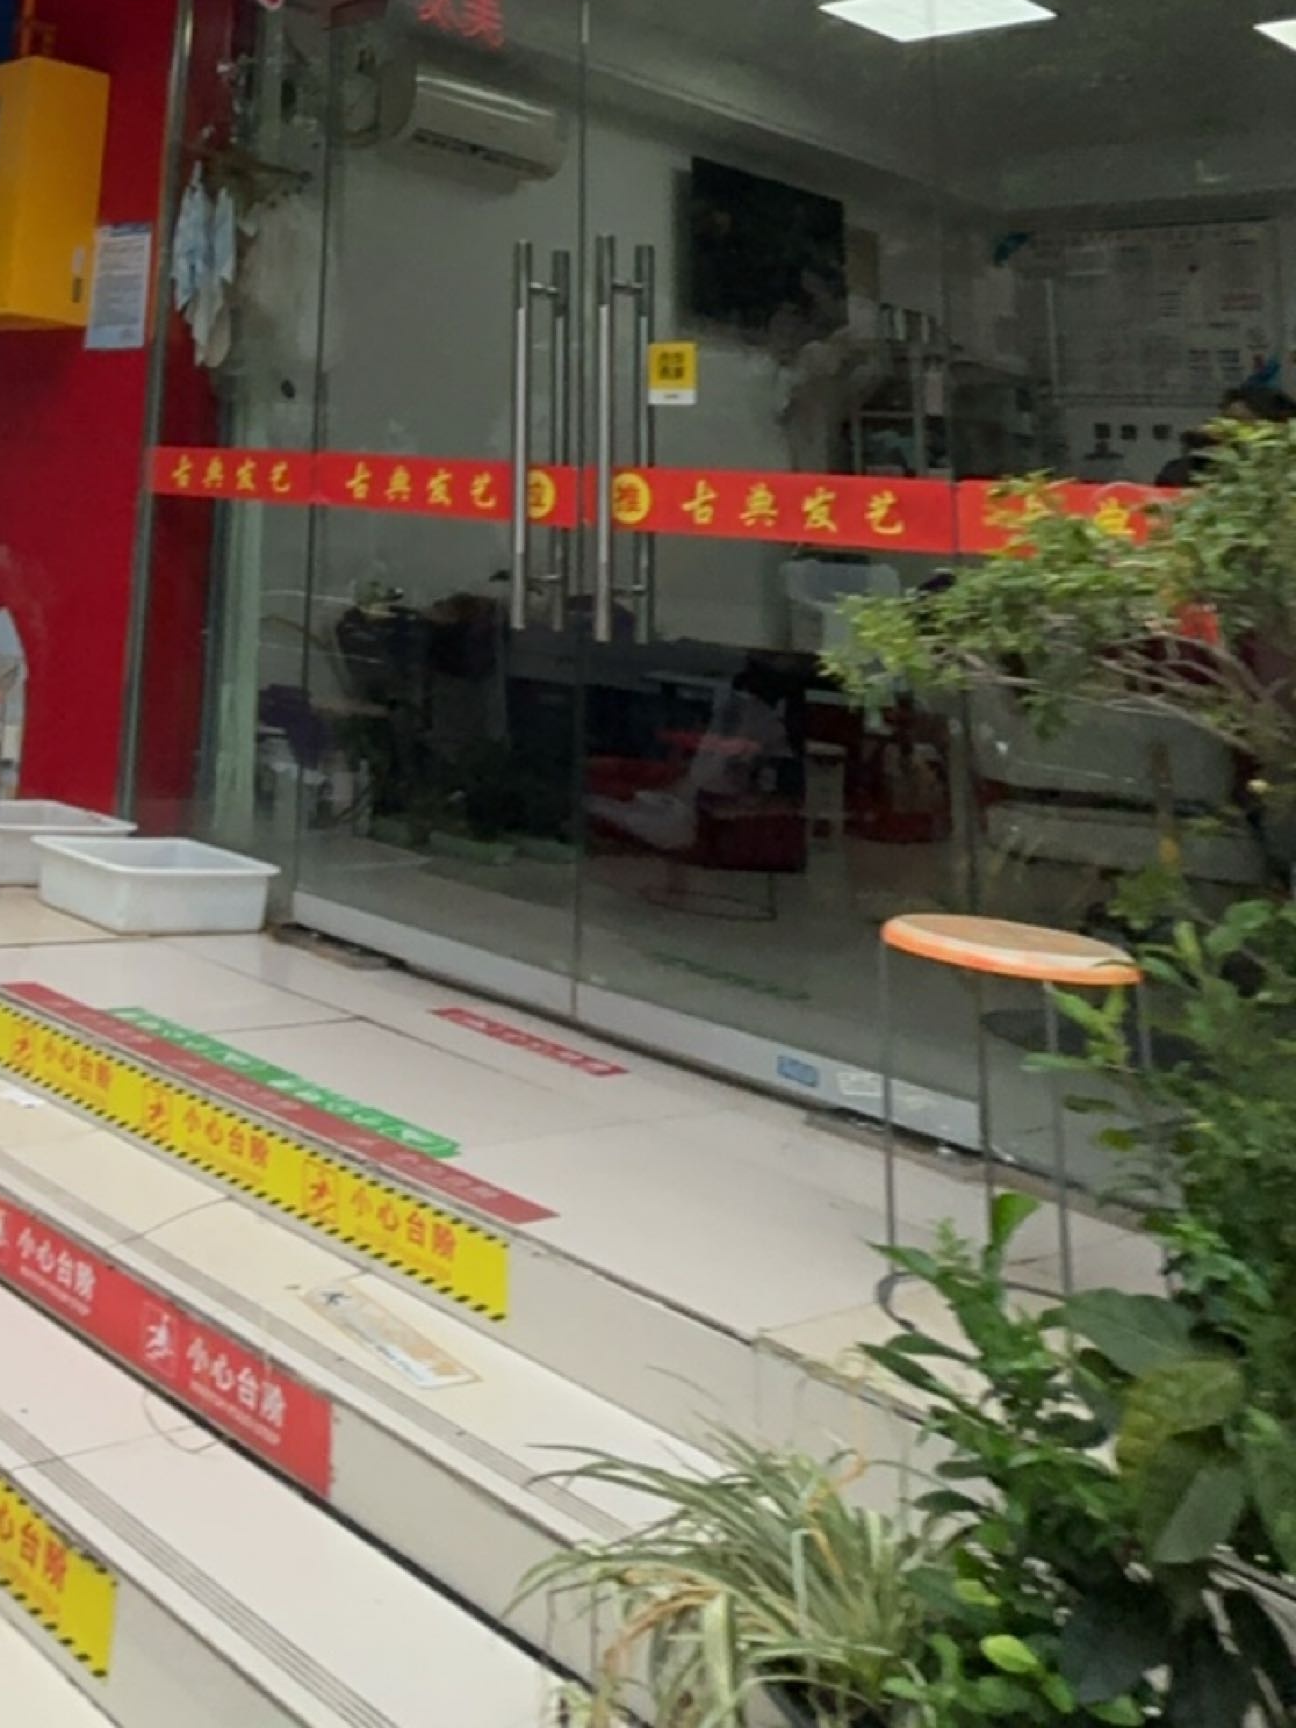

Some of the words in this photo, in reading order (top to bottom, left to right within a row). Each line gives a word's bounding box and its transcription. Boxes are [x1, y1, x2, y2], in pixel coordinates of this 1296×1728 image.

[173, 454, 291, 494] 古典发艺
[345, 461, 497, 510] 古典发艺
[681, 479, 904, 535] 古典发艺
[184, 1106, 270, 1169] 小心台阶
[351, 1186, 457, 1262] 小心台阶
[16, 1227, 96, 1303] 小心台阶
[186, 1337, 287, 1428] 小心台阶
